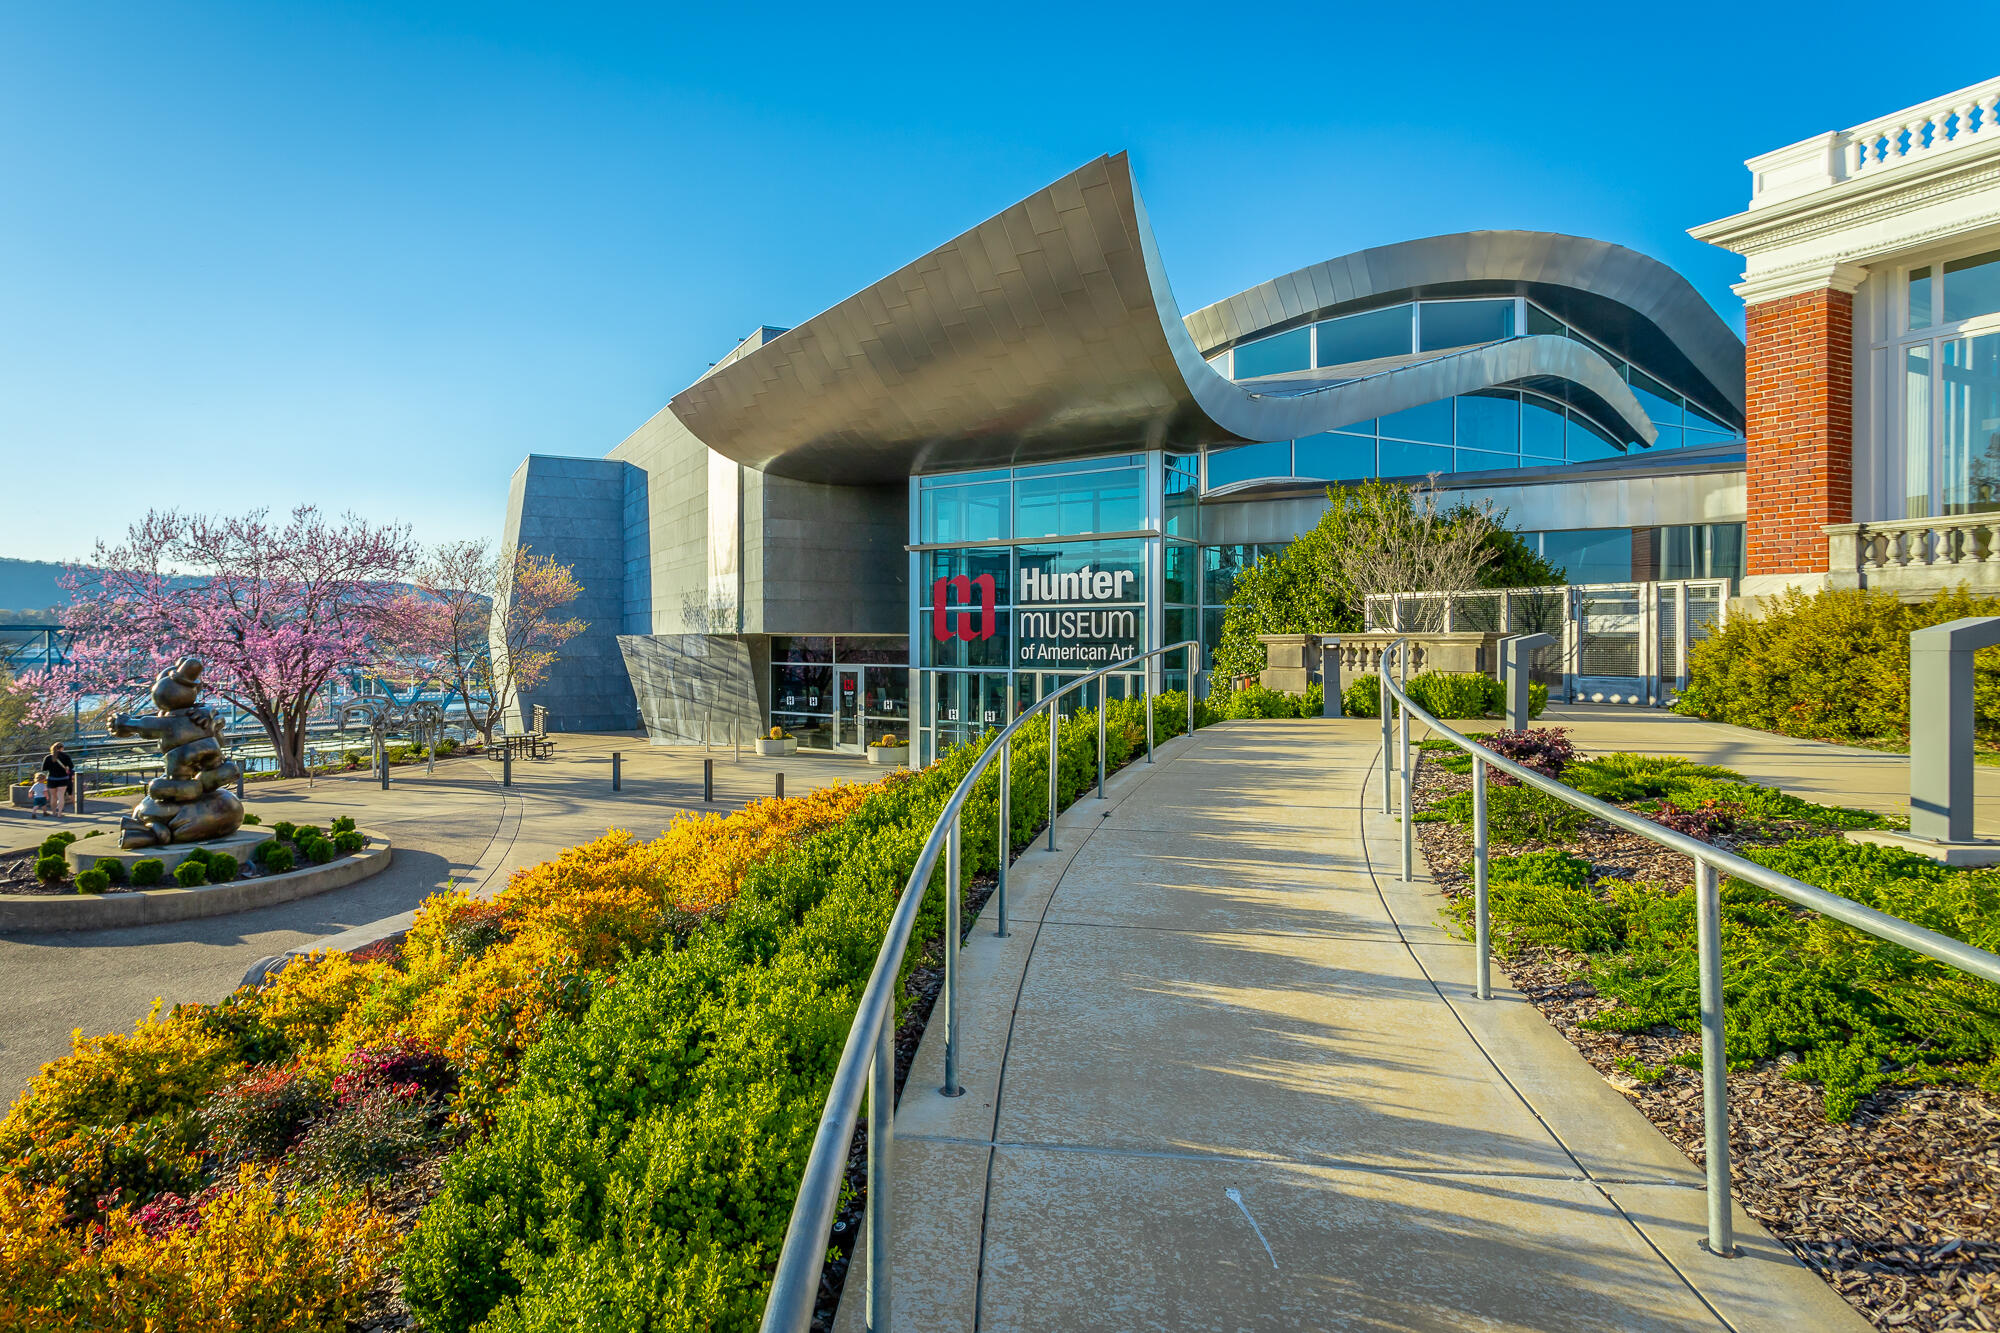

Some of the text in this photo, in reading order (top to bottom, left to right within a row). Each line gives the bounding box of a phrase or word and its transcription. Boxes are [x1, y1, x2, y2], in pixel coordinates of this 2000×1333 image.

[1020, 565, 1134, 601] Hunter
[1020, 643, 1135, 661] of American Art
